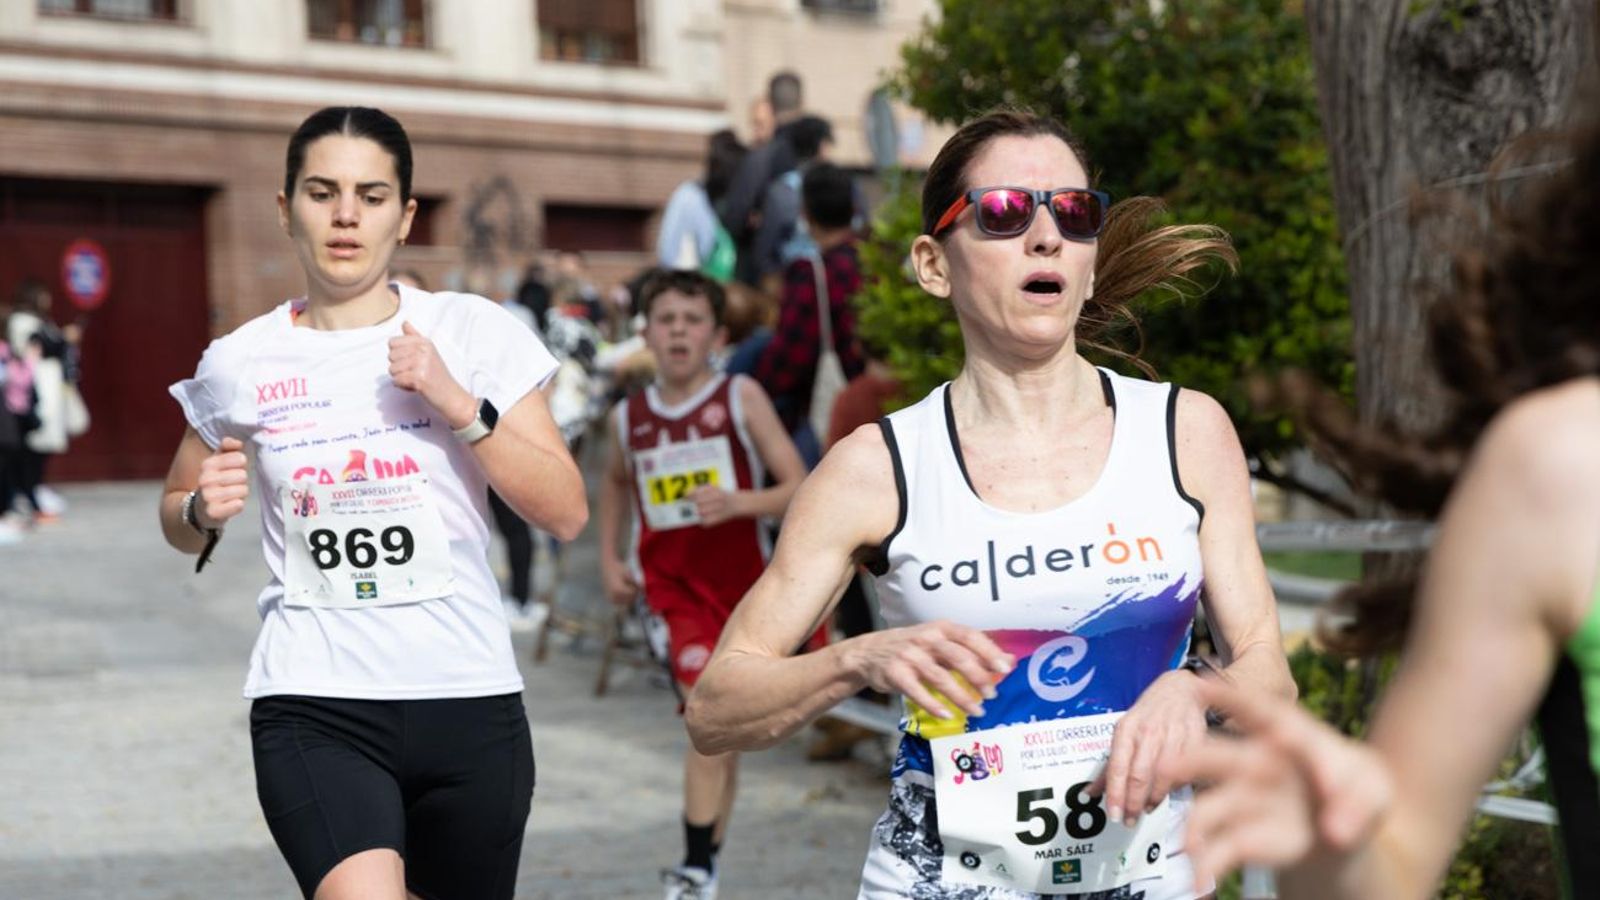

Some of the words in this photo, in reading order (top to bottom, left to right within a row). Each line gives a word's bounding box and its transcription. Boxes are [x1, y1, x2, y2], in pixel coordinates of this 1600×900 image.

[256, 378, 308, 404] XXVII
[309, 525, 414, 569] 869
[920, 523, 1162, 601] calderón
[1106, 576, 1141, 585] desde
[1056, 725, 1099, 741] CARRERA
[1015, 781, 1107, 845] 58
[1034, 848, 1062, 860] MAR
